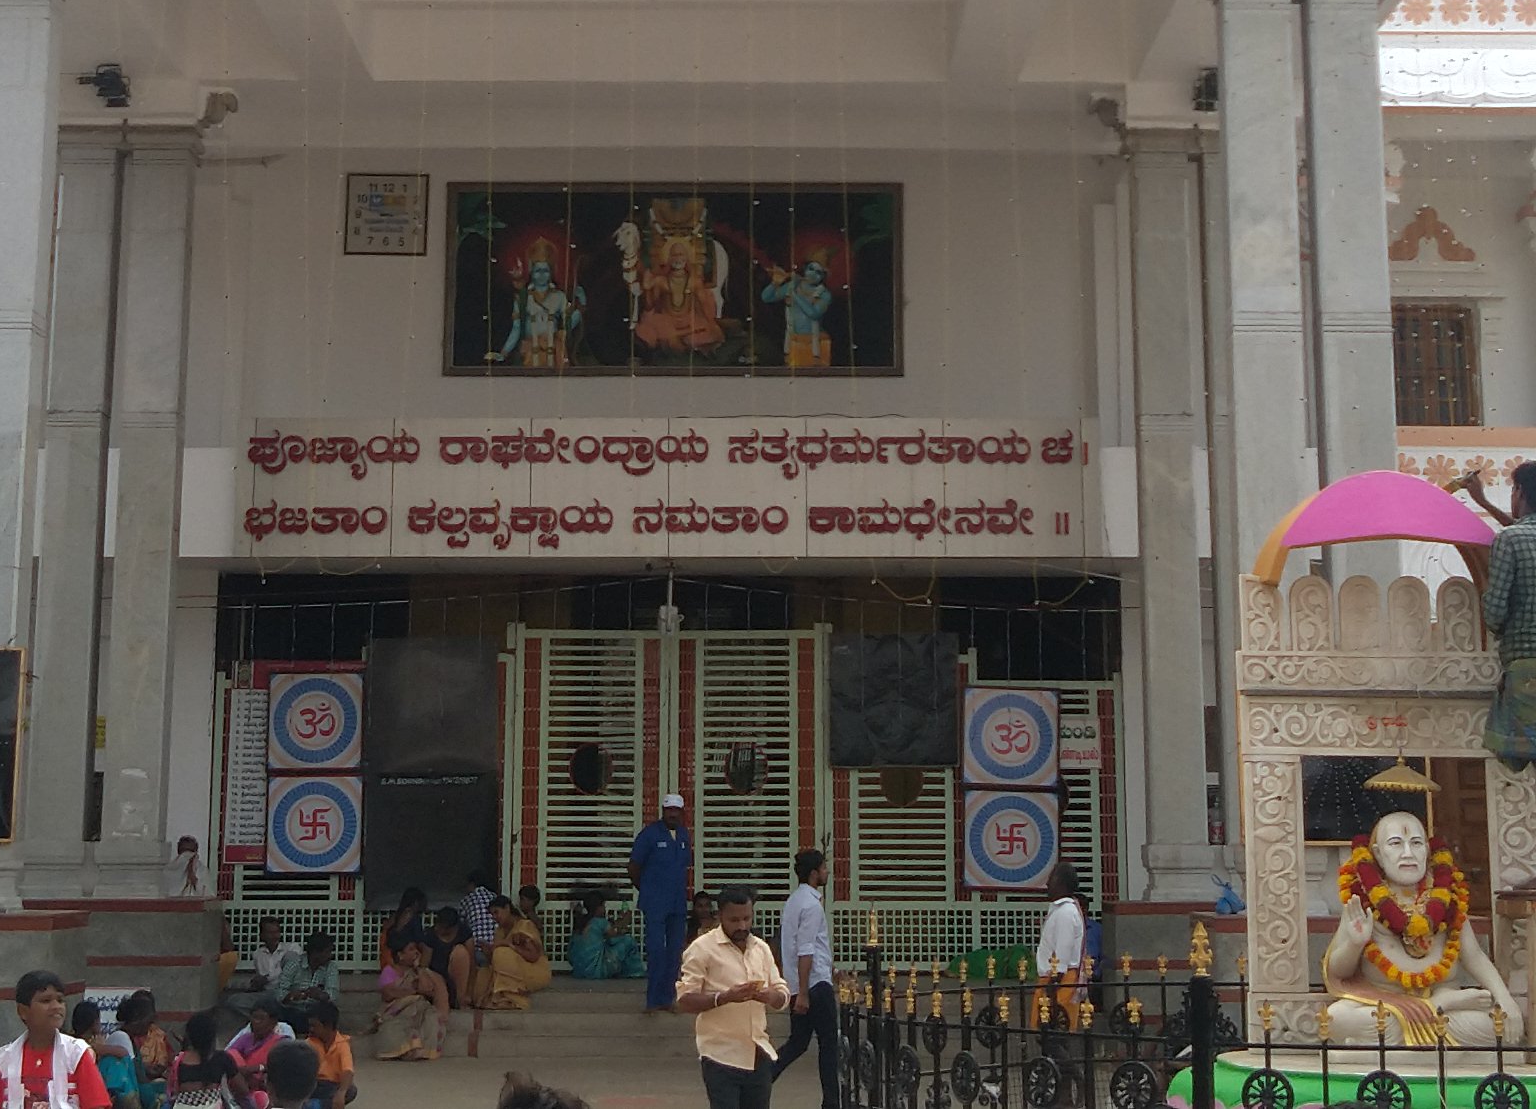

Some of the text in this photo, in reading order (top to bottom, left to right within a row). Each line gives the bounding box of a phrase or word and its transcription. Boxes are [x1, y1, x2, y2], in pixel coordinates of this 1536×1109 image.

[247, 428, 421, 481] ಪೂಜ್ಯಾಯ
[439, 427, 709, 477] ರಾಘವೇಂದ್ರಾಯ
[727, 428, 1032, 480] ಸತ್ಯಧರ್ಮರತಾಯ
[244, 499, 389, 542] ಭಜತಾಂ
[407, 498, 615, 551] ಕಲ್ಪವೃಕ್ಷಾಯ
[632, 498, 790, 536] ನಮತಾಂ
[807, 497, 1035, 542] ಕಾಮಧೇನವೇ
